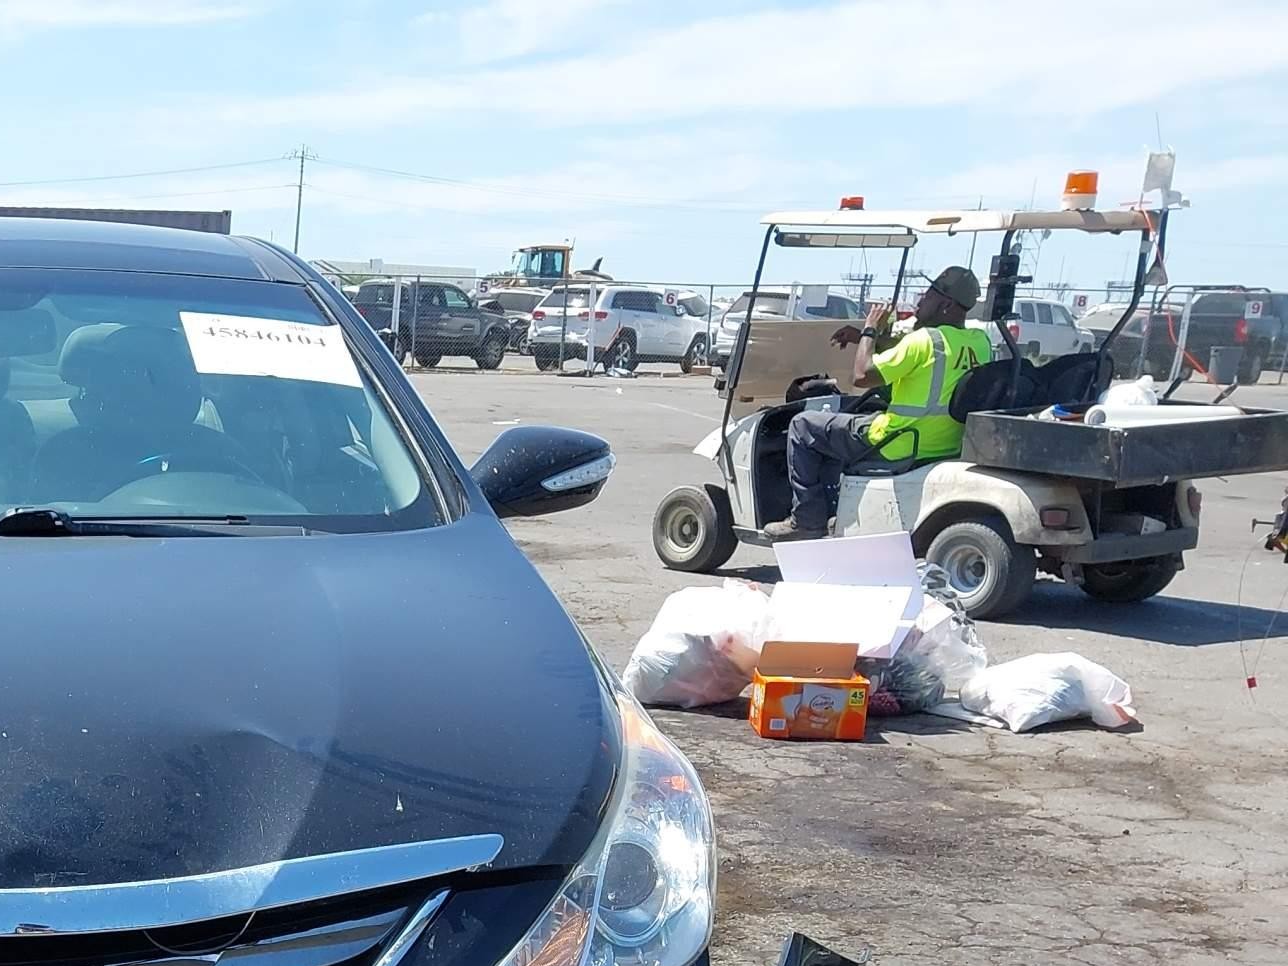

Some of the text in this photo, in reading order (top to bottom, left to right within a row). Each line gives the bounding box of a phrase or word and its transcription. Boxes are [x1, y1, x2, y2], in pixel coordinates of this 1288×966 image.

[480, 281, 488, 294] 5
[666, 292, 675, 305] 6
[1077, 295, 1087, 307] 8
[1251, 302, 1261, 314] 9
[203, 326, 326, 347] 45846104
[851, 691, 864, 699] 45
